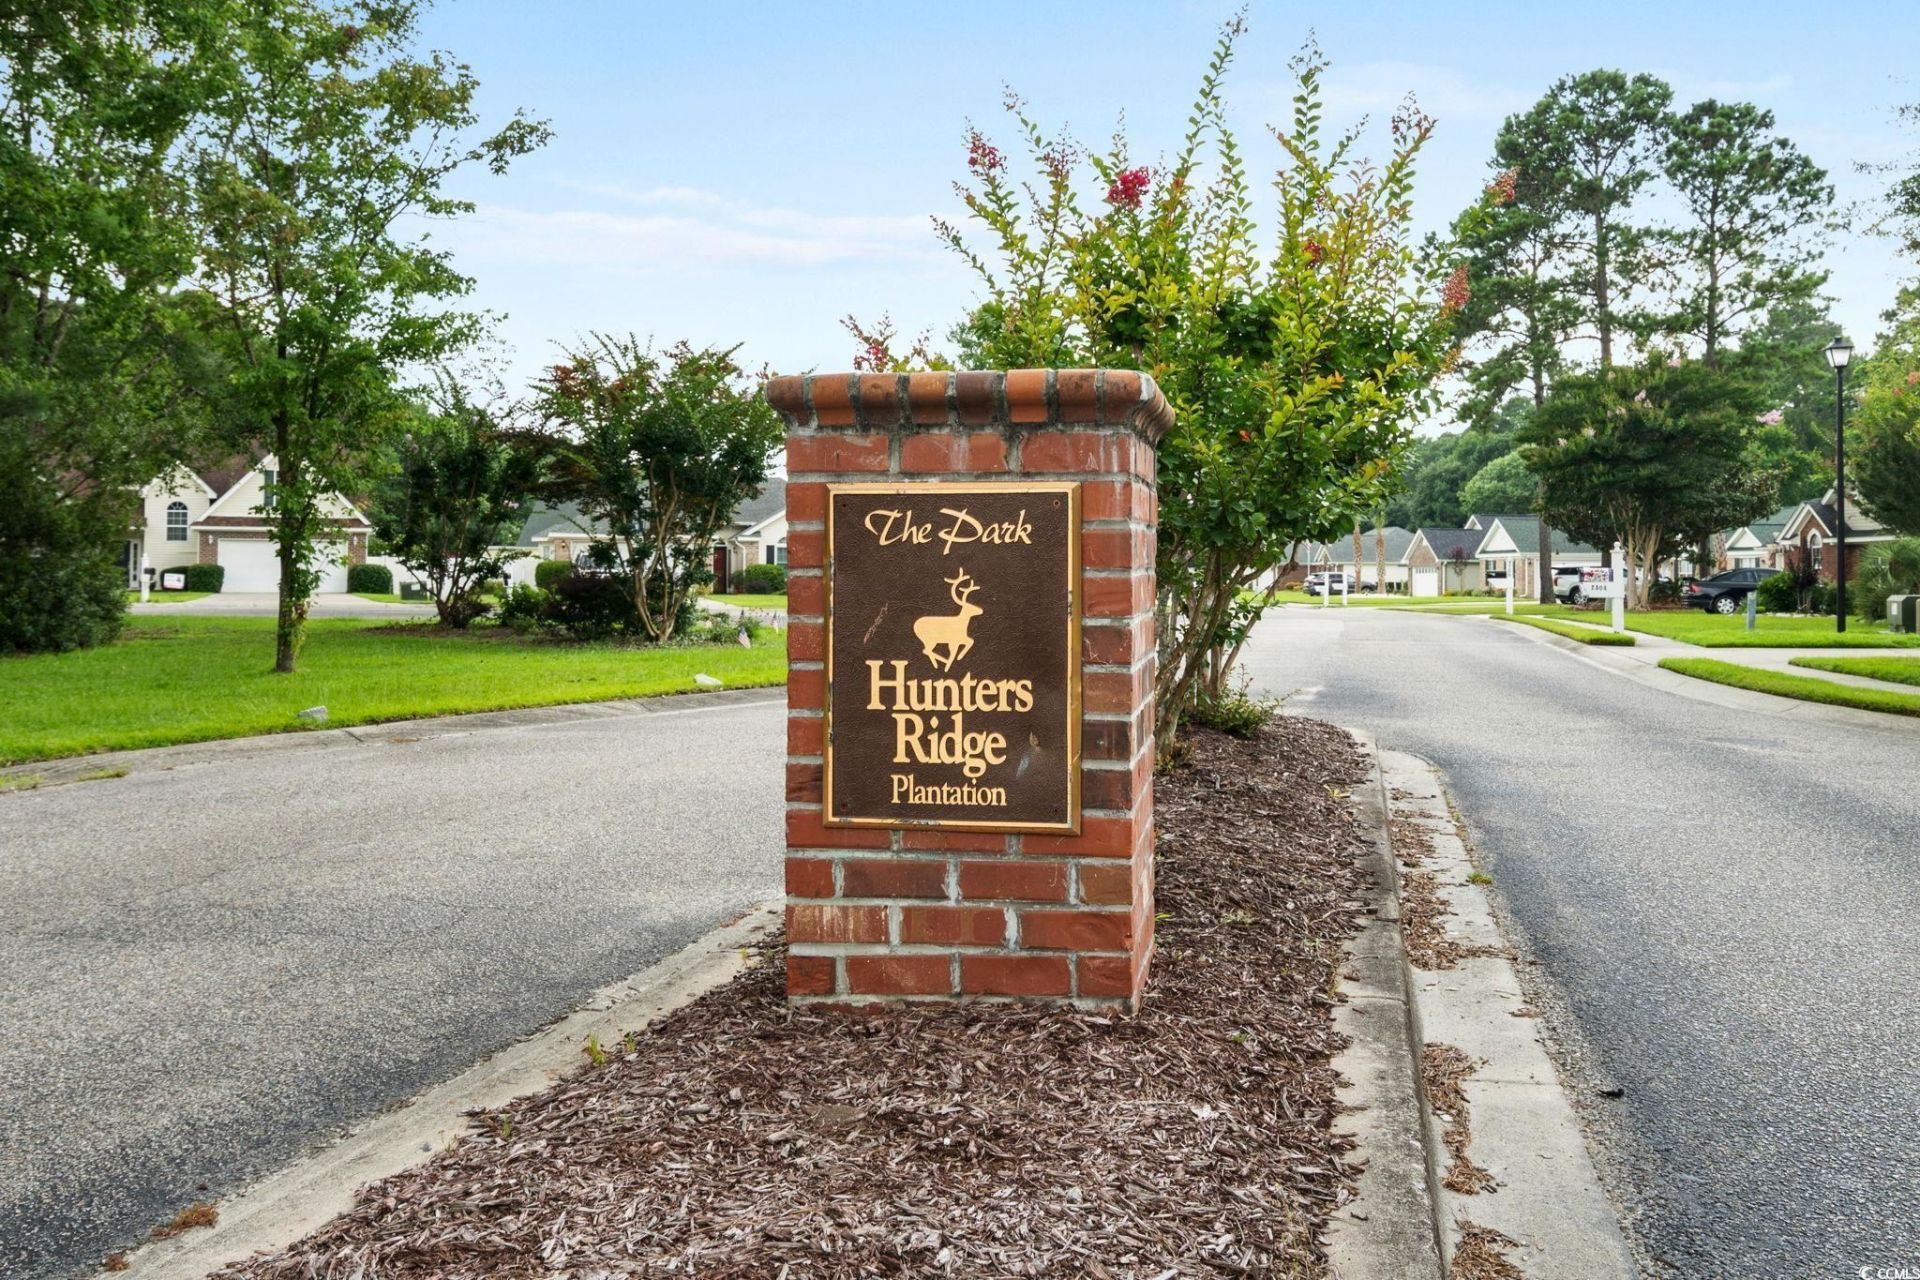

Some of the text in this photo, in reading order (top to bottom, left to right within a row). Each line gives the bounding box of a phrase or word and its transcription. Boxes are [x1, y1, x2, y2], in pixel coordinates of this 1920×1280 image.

[864, 508, 1032, 555] The Park
[865, 660, 1034, 712] Hunters
[891, 712, 1007, 778] Ridge
[890, 774, 1007, 806] Plantation
